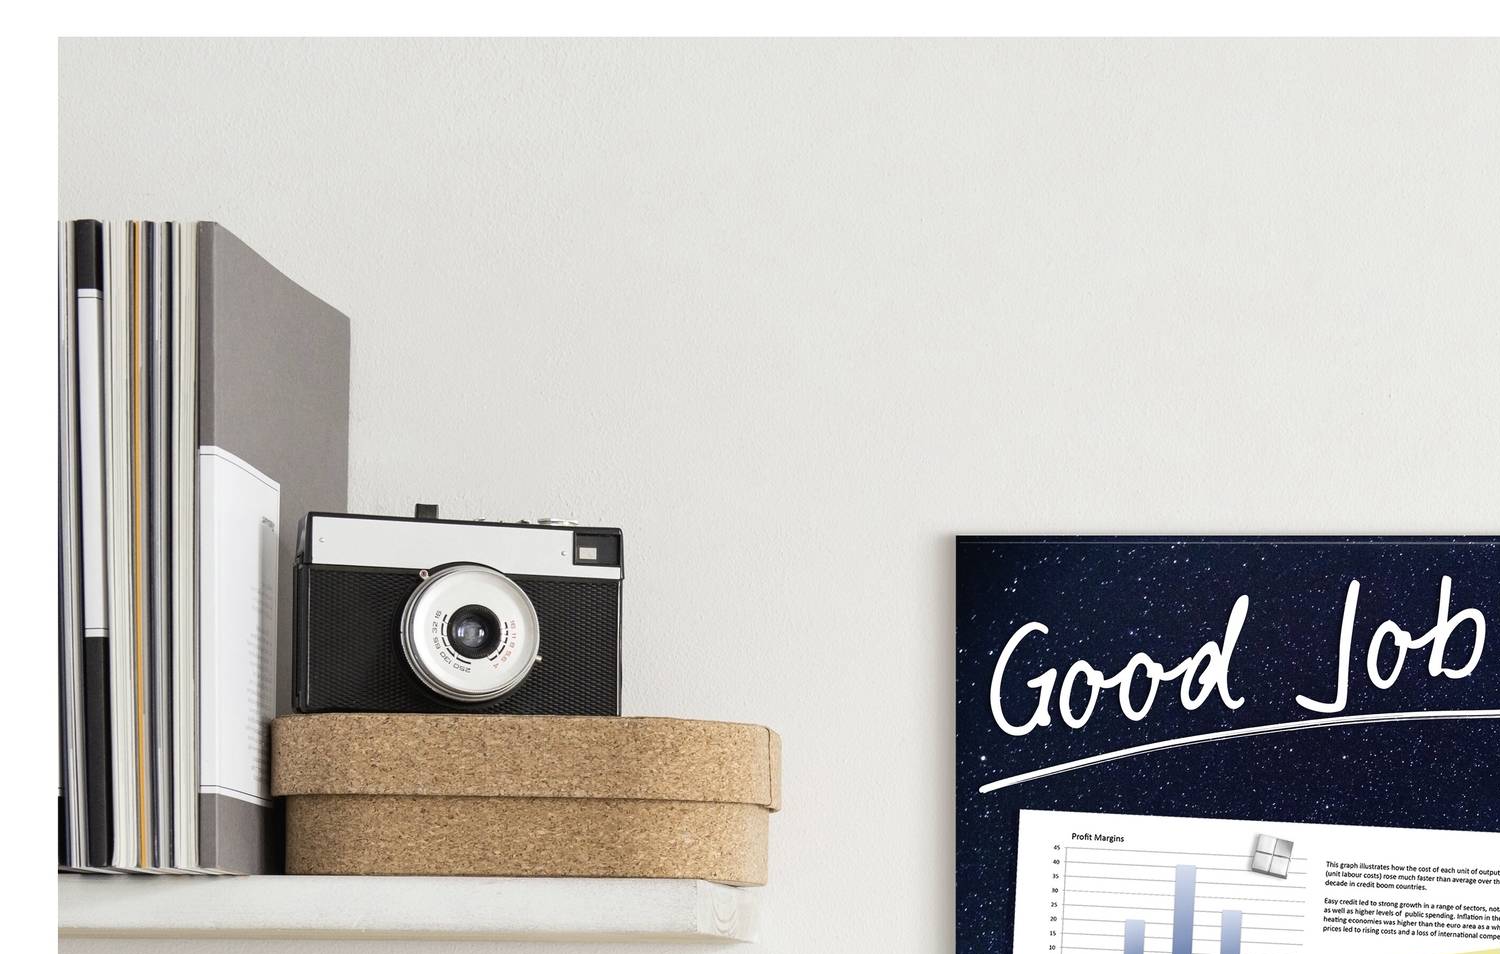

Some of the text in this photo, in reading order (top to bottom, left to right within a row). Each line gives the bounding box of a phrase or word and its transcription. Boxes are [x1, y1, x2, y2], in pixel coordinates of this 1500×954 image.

[453, 663, 471, 673] 250
[988, 593, 1251, 737] Good
[1072, 832, 1124, 844] Profit Margins
[1359, 862, 1390, 871] illustrates
[1452, 877, 1477, 885] average
[1324, 897, 1339, 905] Easy
[1354, 908, 1375, 916] higher
[1425, 912, 1456, 920] spending.
[1323, 916, 1348, 925] heating
[1396, 919, 1417, 927] higher
[1362, 926, 1380, 936] rising
[1437, 930, 1478, 939] international
